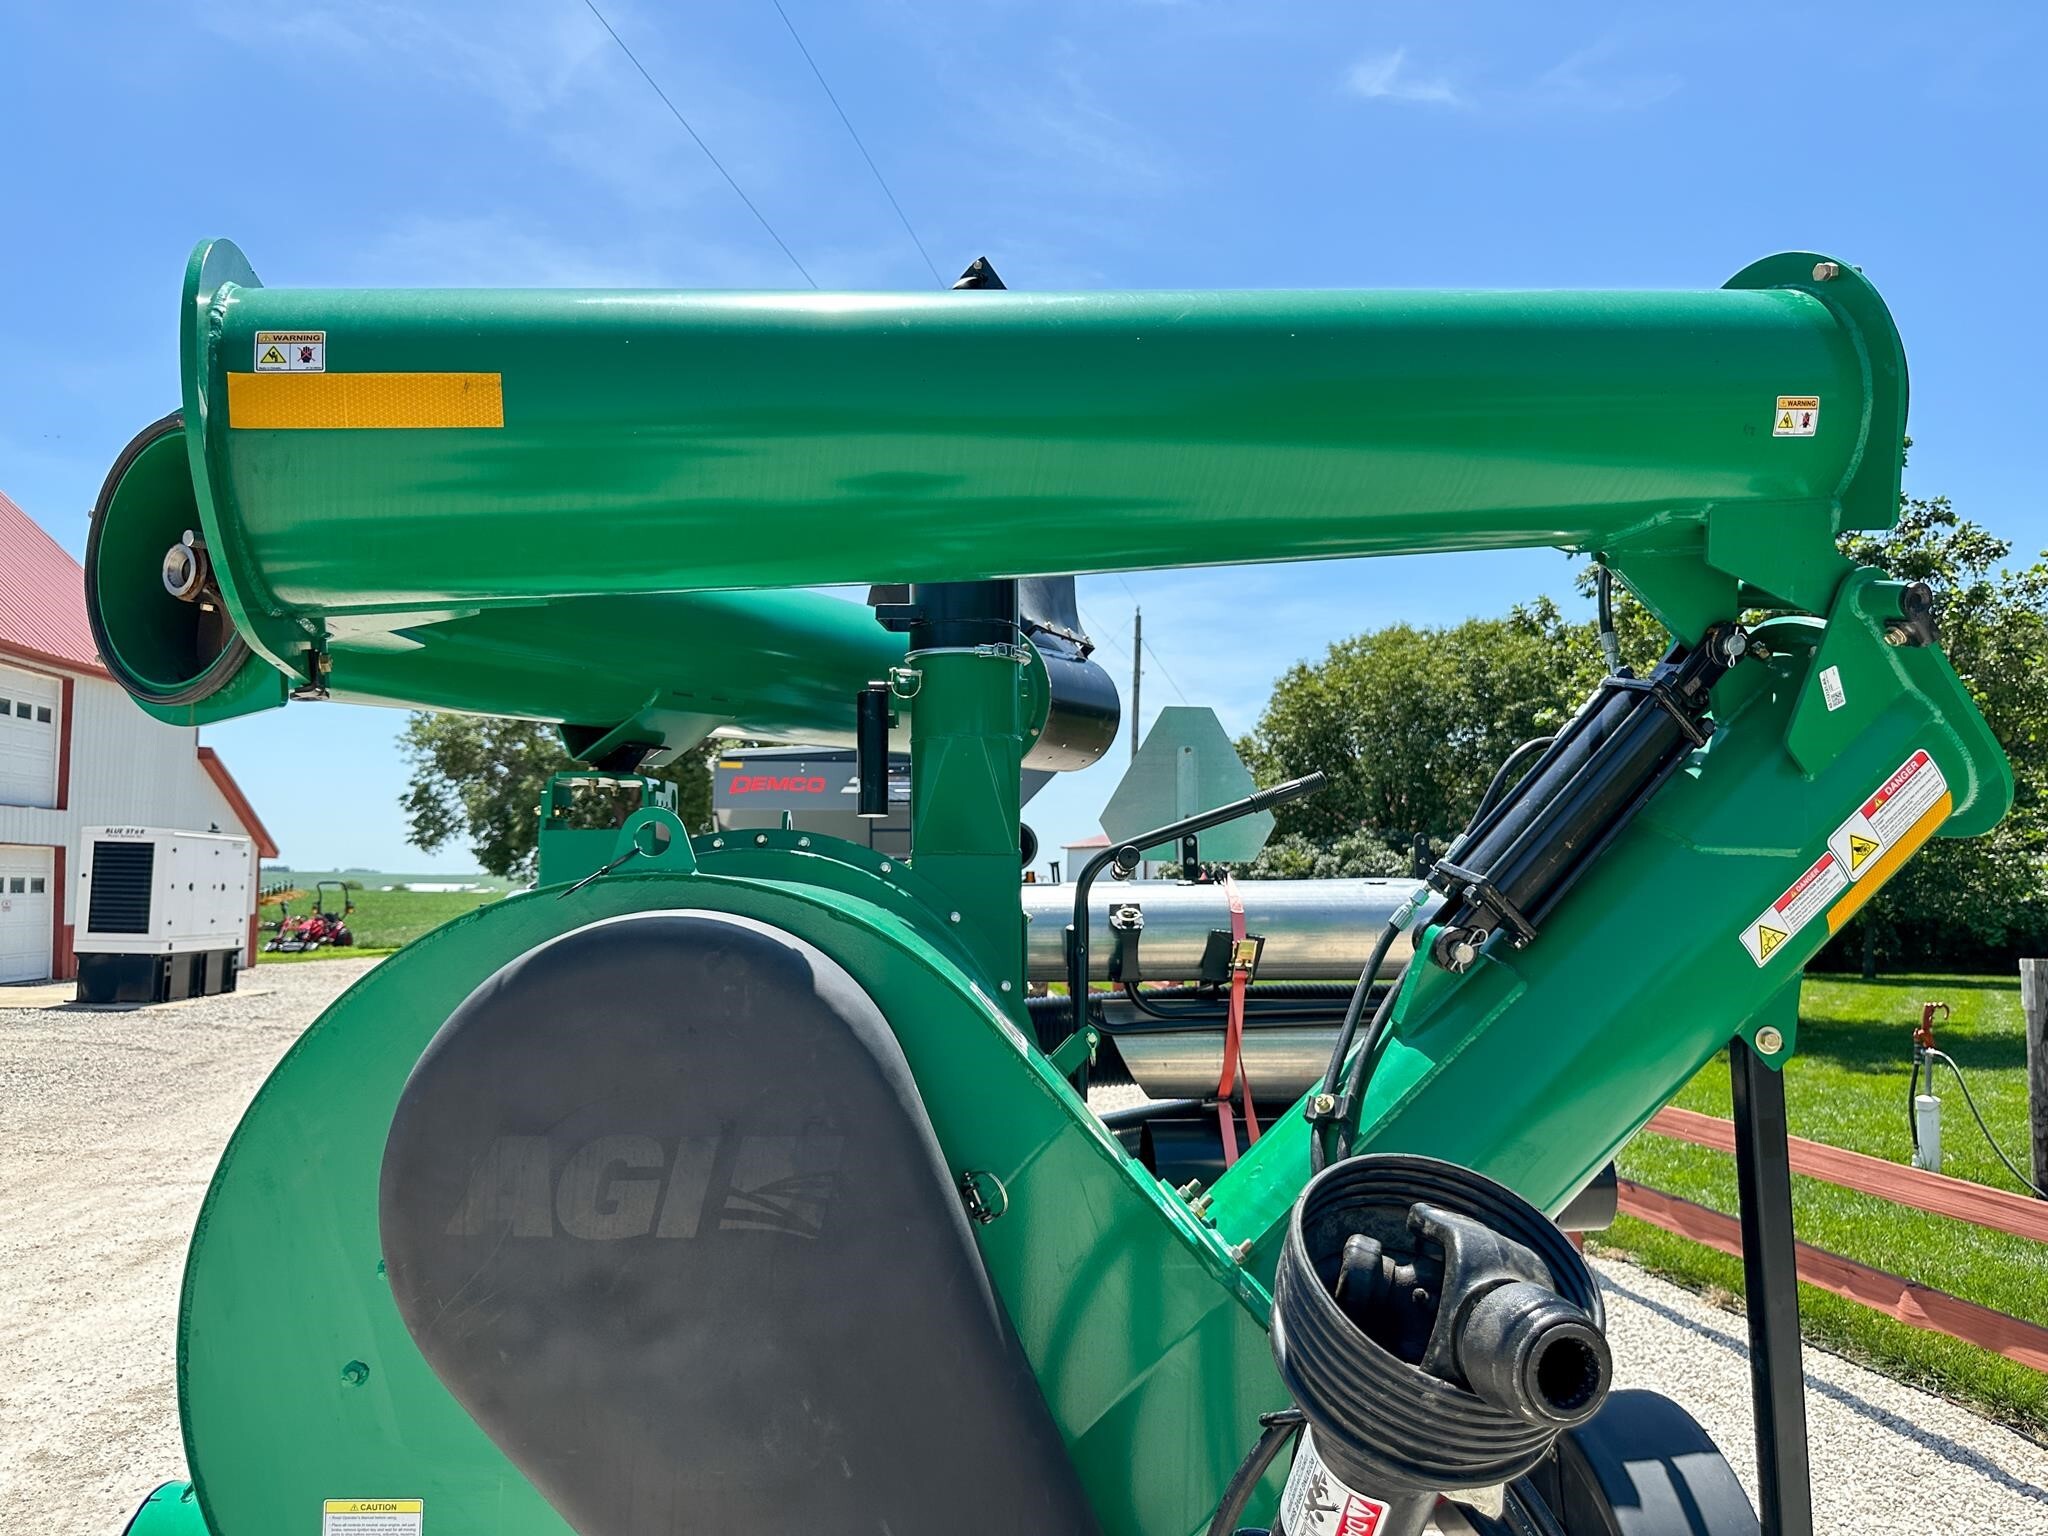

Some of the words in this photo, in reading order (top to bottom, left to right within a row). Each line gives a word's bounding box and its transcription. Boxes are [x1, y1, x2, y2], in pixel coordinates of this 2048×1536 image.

[729, 776, 827, 795] DEMCO
[1884, 761, 1919, 796] DANGER
[1795, 868, 1820, 892] DANGER
[445, 1134, 722, 1240] AGI
[360, 1503, 397, 1511] CAUTION
